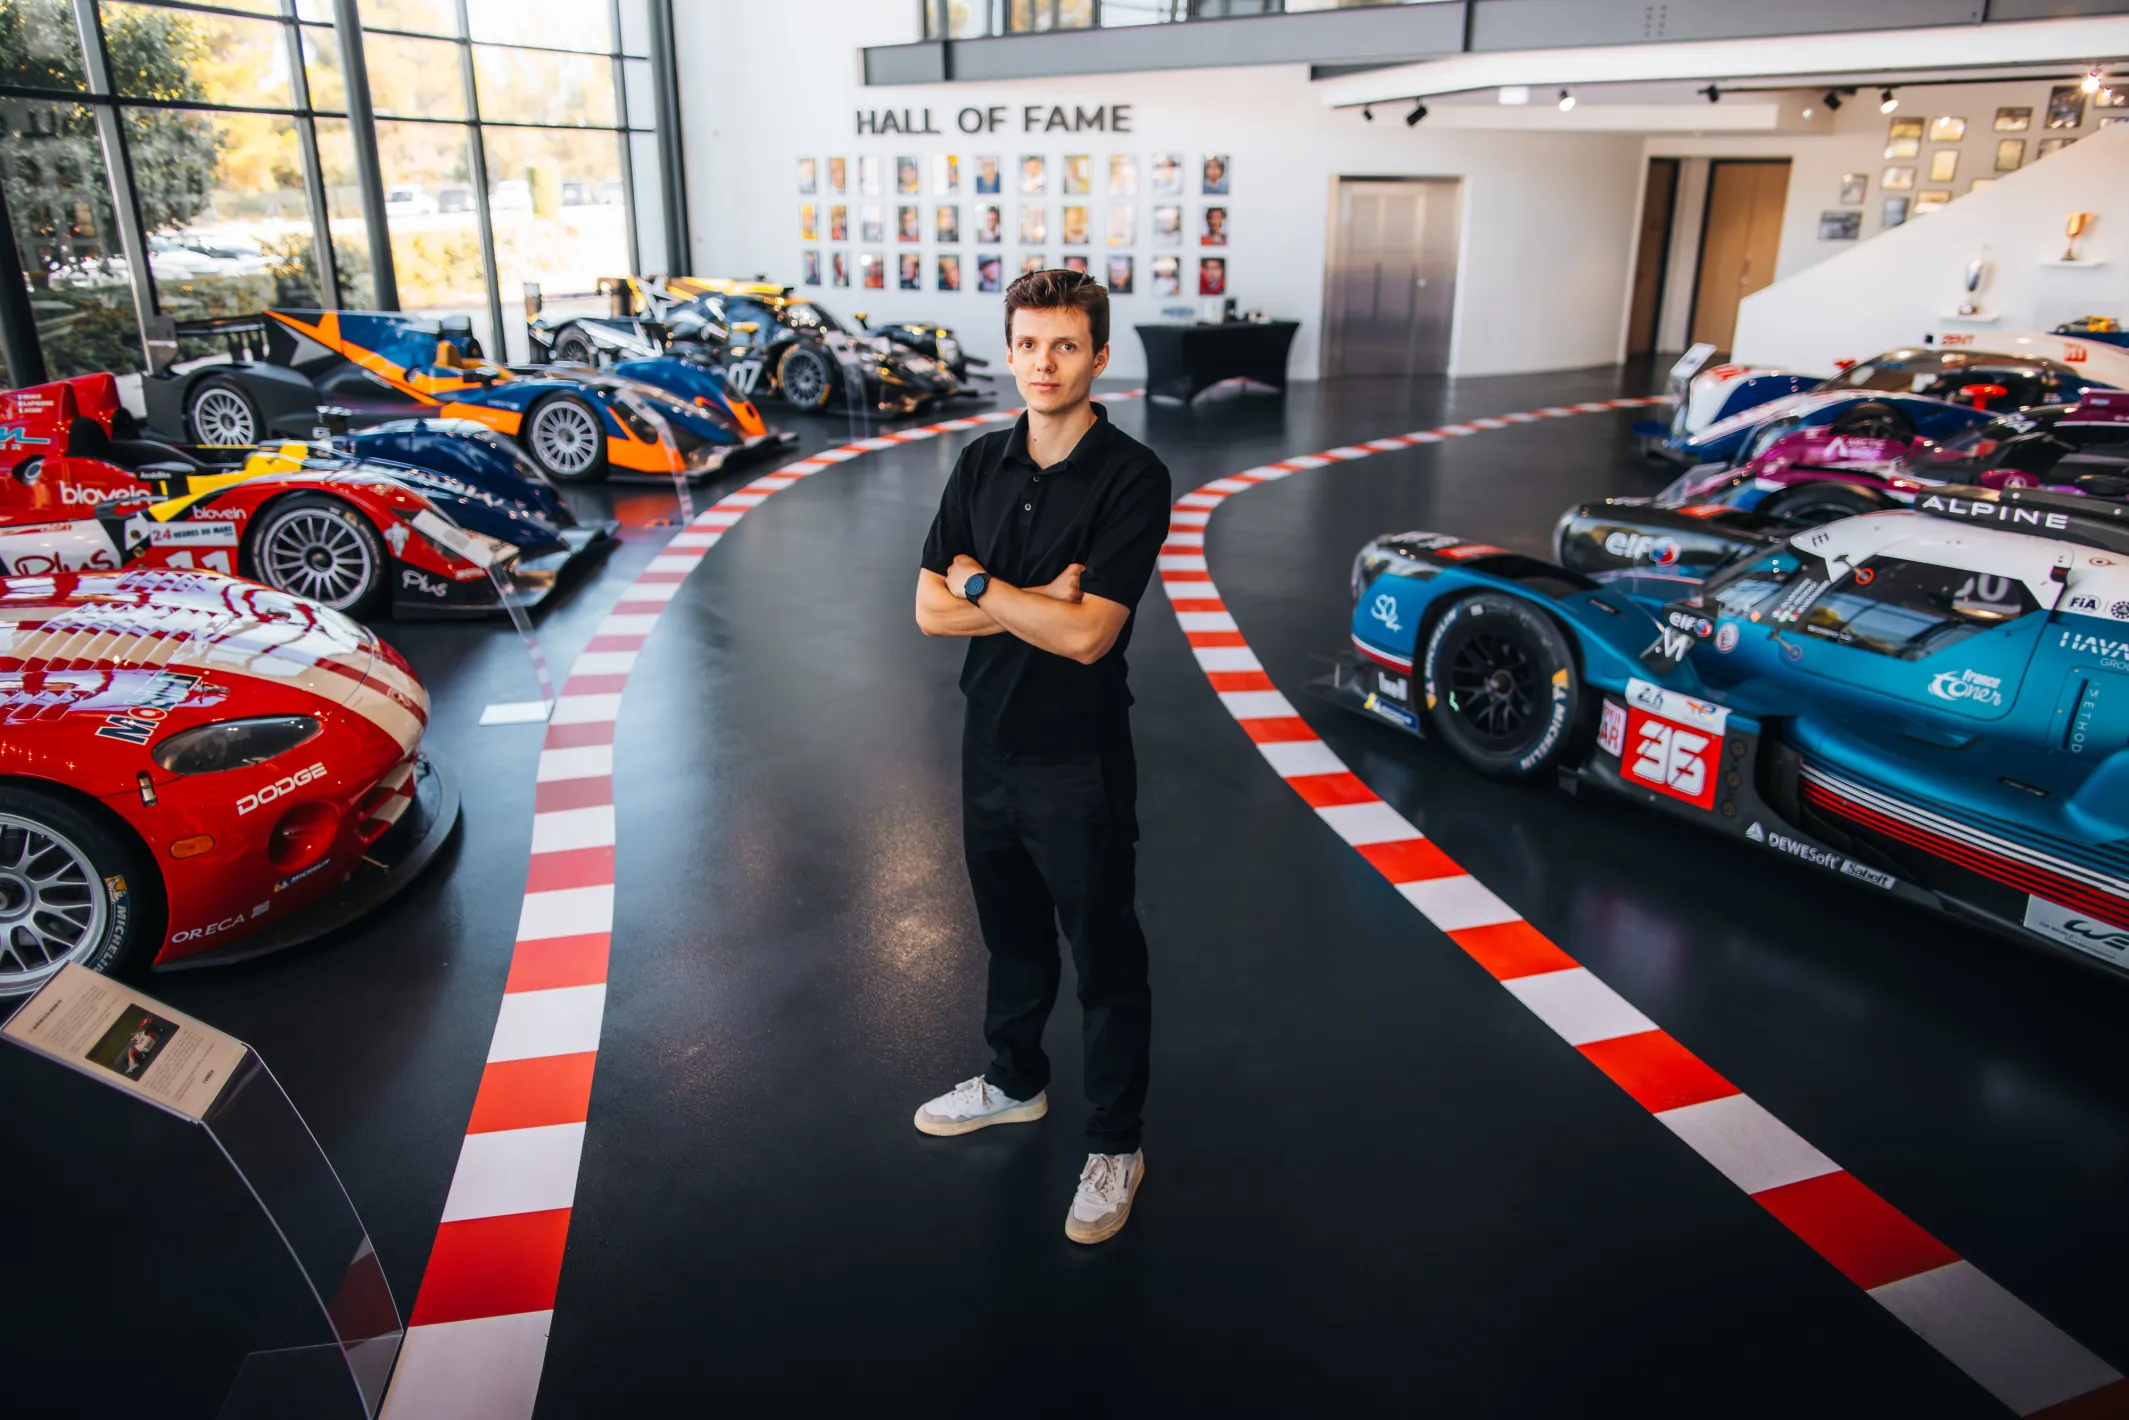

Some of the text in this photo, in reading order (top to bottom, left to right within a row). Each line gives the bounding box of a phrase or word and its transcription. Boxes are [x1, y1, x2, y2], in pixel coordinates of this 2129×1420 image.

[856, 104, 1132, 135] HALL OF FAME
[729, 360, 763, 394] 07
[59, 480, 152, 506] biovein
[192, 504, 247, 520] biovein
[1922, 495, 2069, 530] ALPINE
[152, 525, 233, 542] 24 HEURES DU MANS
[1605, 532, 1655, 560] elf
[402, 570, 448, 597] Plus
[2069, 597, 2097, 610] FIA
[1669, 611, 1698, 631] elf
[1521, 702, 1566, 770] MICHELIN
[1632, 719, 1710, 796] 36
[236, 761, 328, 816] DODGE
[1768, 832, 1838, 870] DEWESoft
[171, 914, 245, 944] ORECA
